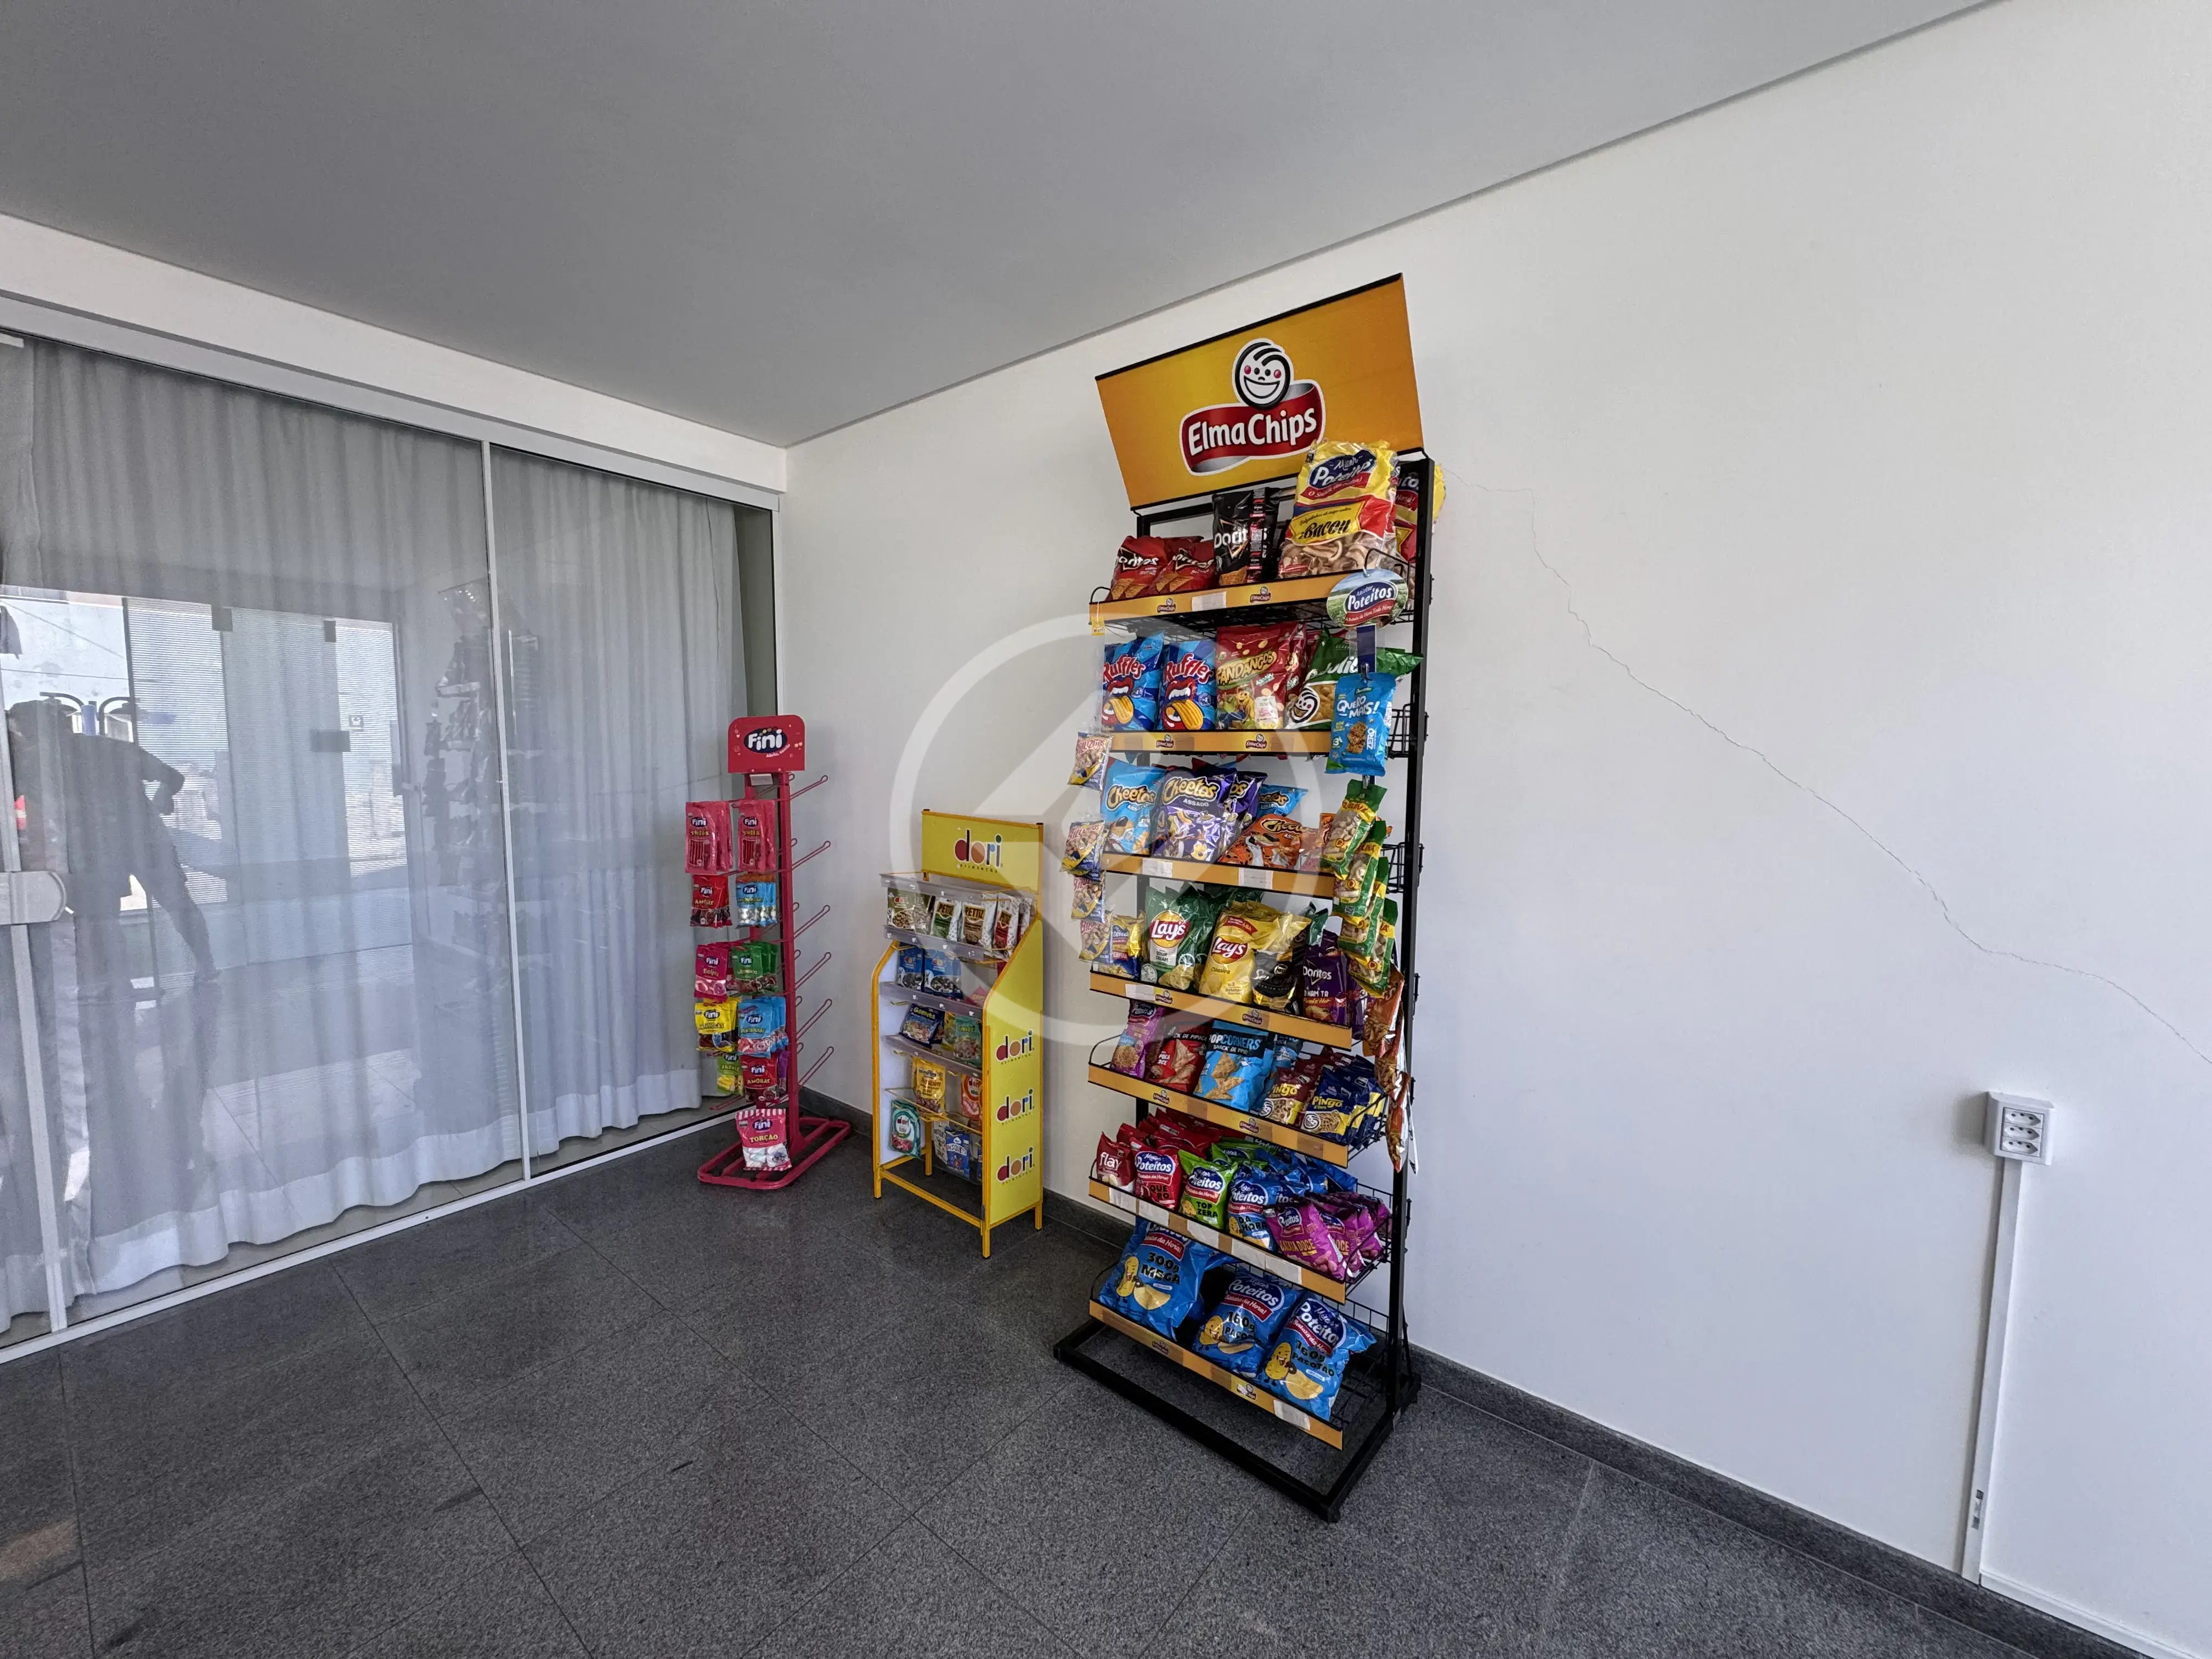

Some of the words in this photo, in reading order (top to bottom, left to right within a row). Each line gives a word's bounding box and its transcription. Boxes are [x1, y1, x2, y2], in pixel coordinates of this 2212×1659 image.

[1347, 586, 1392, 611] Poteitos
[1164, 653, 1214, 684] Ruffles
[1216, 651, 1278, 685] FANDANGOS
[748, 729, 783, 751] Fini
[1107, 785, 1156, 810] Cheetos
[1163, 777, 1220, 804] Cheetos
[1182, 798, 1210, 808] ASSADO
[692, 817, 707, 826] Fini
[744, 817, 758, 826] Fini
[955, 828, 1002, 867] dori
[744, 885, 757, 894] Fini
[965, 906, 985, 919] PETTIZ
[1152, 919, 1186, 940] Lay's
[706, 957, 718, 965] Fini
[1303, 966, 1332, 980] Doritos
[747, 1015, 762, 1024] Fini
[996, 1029, 1033, 1061] dori
[751, 1065, 766, 1074] Fini
[997, 1088, 1034, 1122] dori
[754, 1119, 771, 1130] Fini
[997, 1147, 1034, 1182] dori
[1136, 1156, 1171, 1173] Poteitos
[1196, 1201, 1213, 1210] TOP
[1197, 1209, 1218, 1217] ZERA
[1140, 1263, 1180, 1284] MEGA
[1229, 1279, 1279, 1306] Poteitos
[1295, 1339, 1325, 1362] 160g
